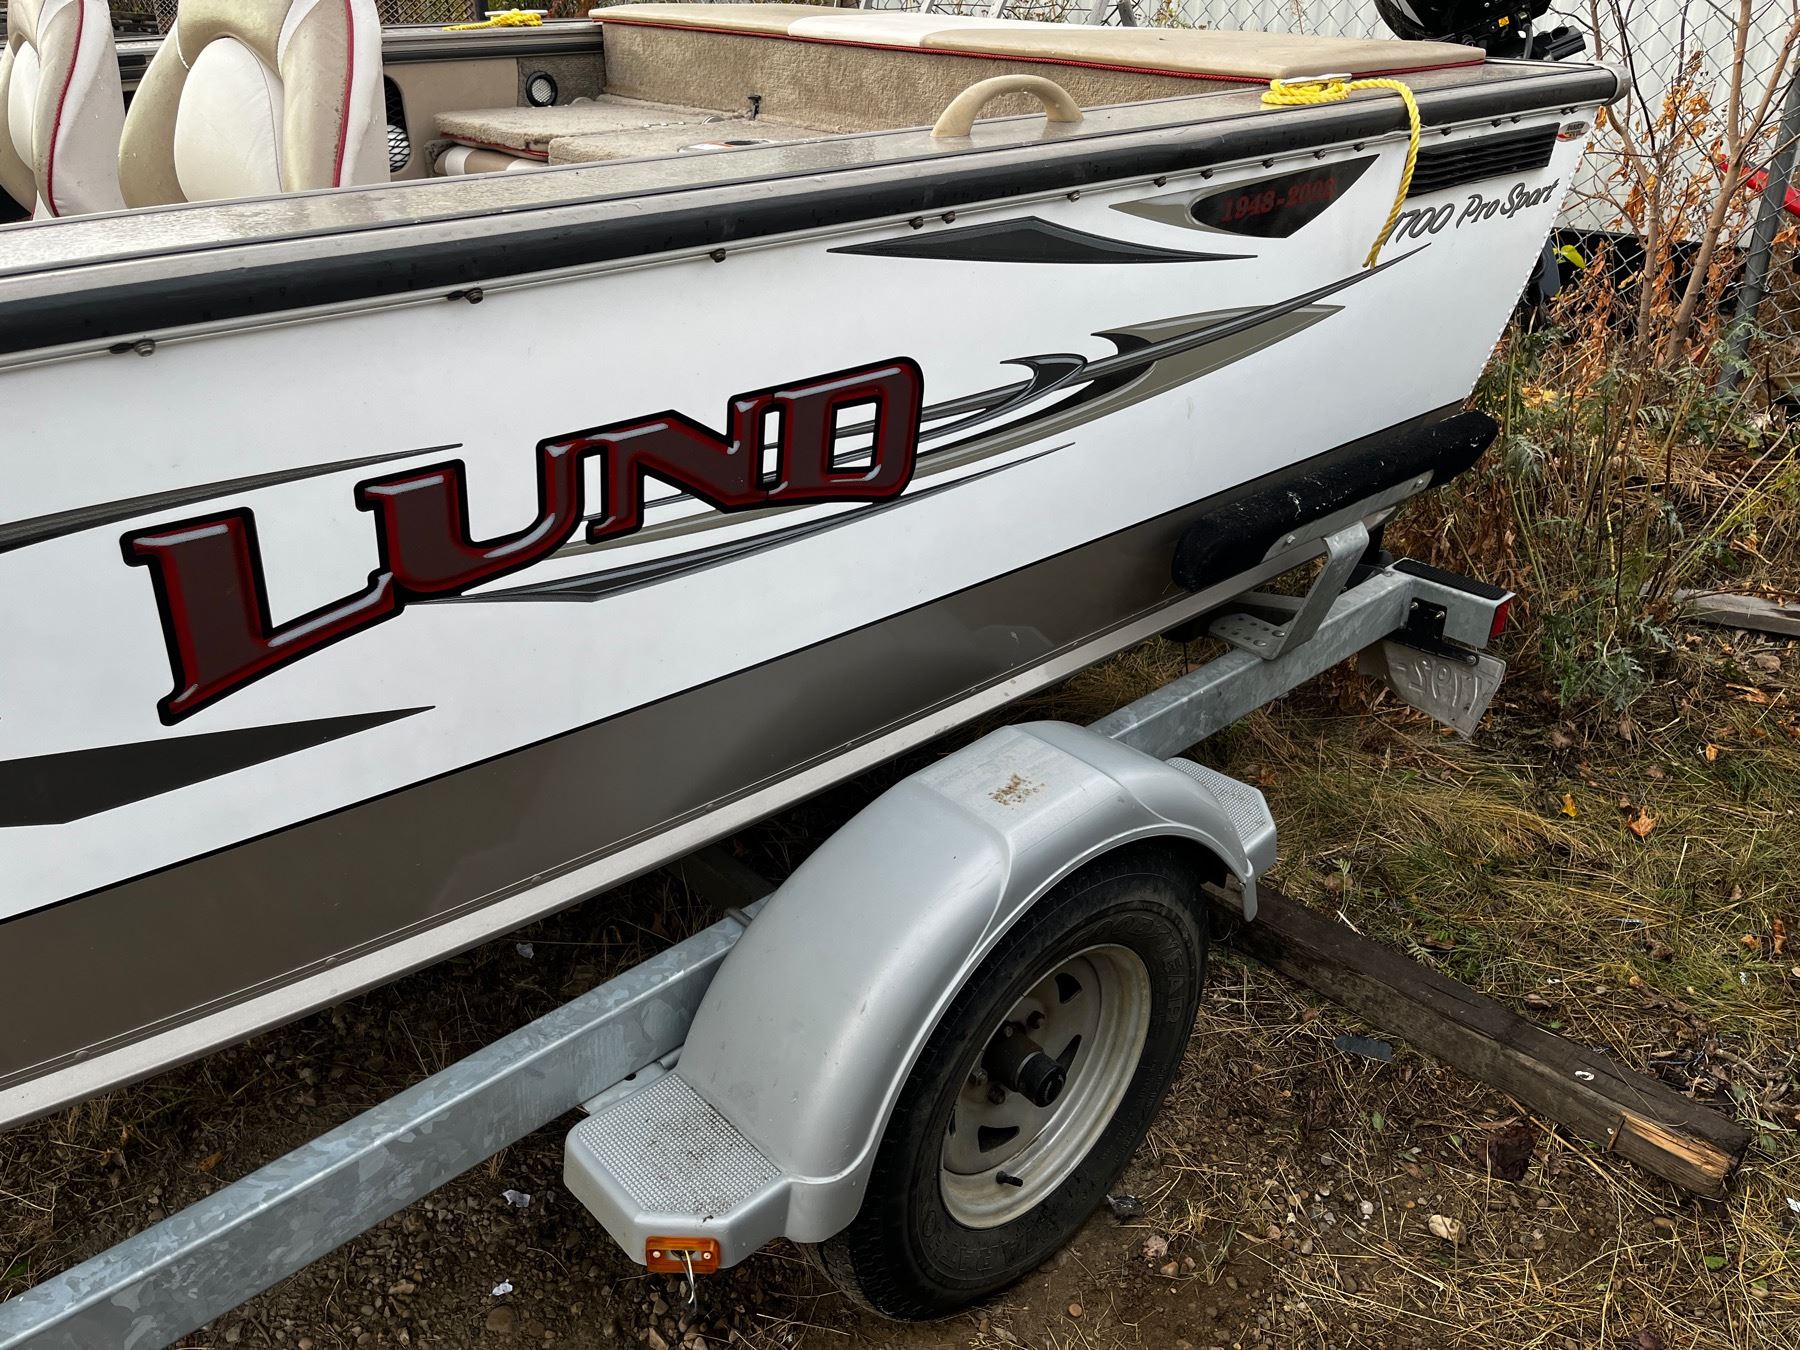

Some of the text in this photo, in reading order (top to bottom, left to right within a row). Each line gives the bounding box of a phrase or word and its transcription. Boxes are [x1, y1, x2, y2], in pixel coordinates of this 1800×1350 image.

[1456, 193, 1500, 229] Pro
[1500, 178, 1560, 219] Sport
[121, 356, 924, 726] LUND
